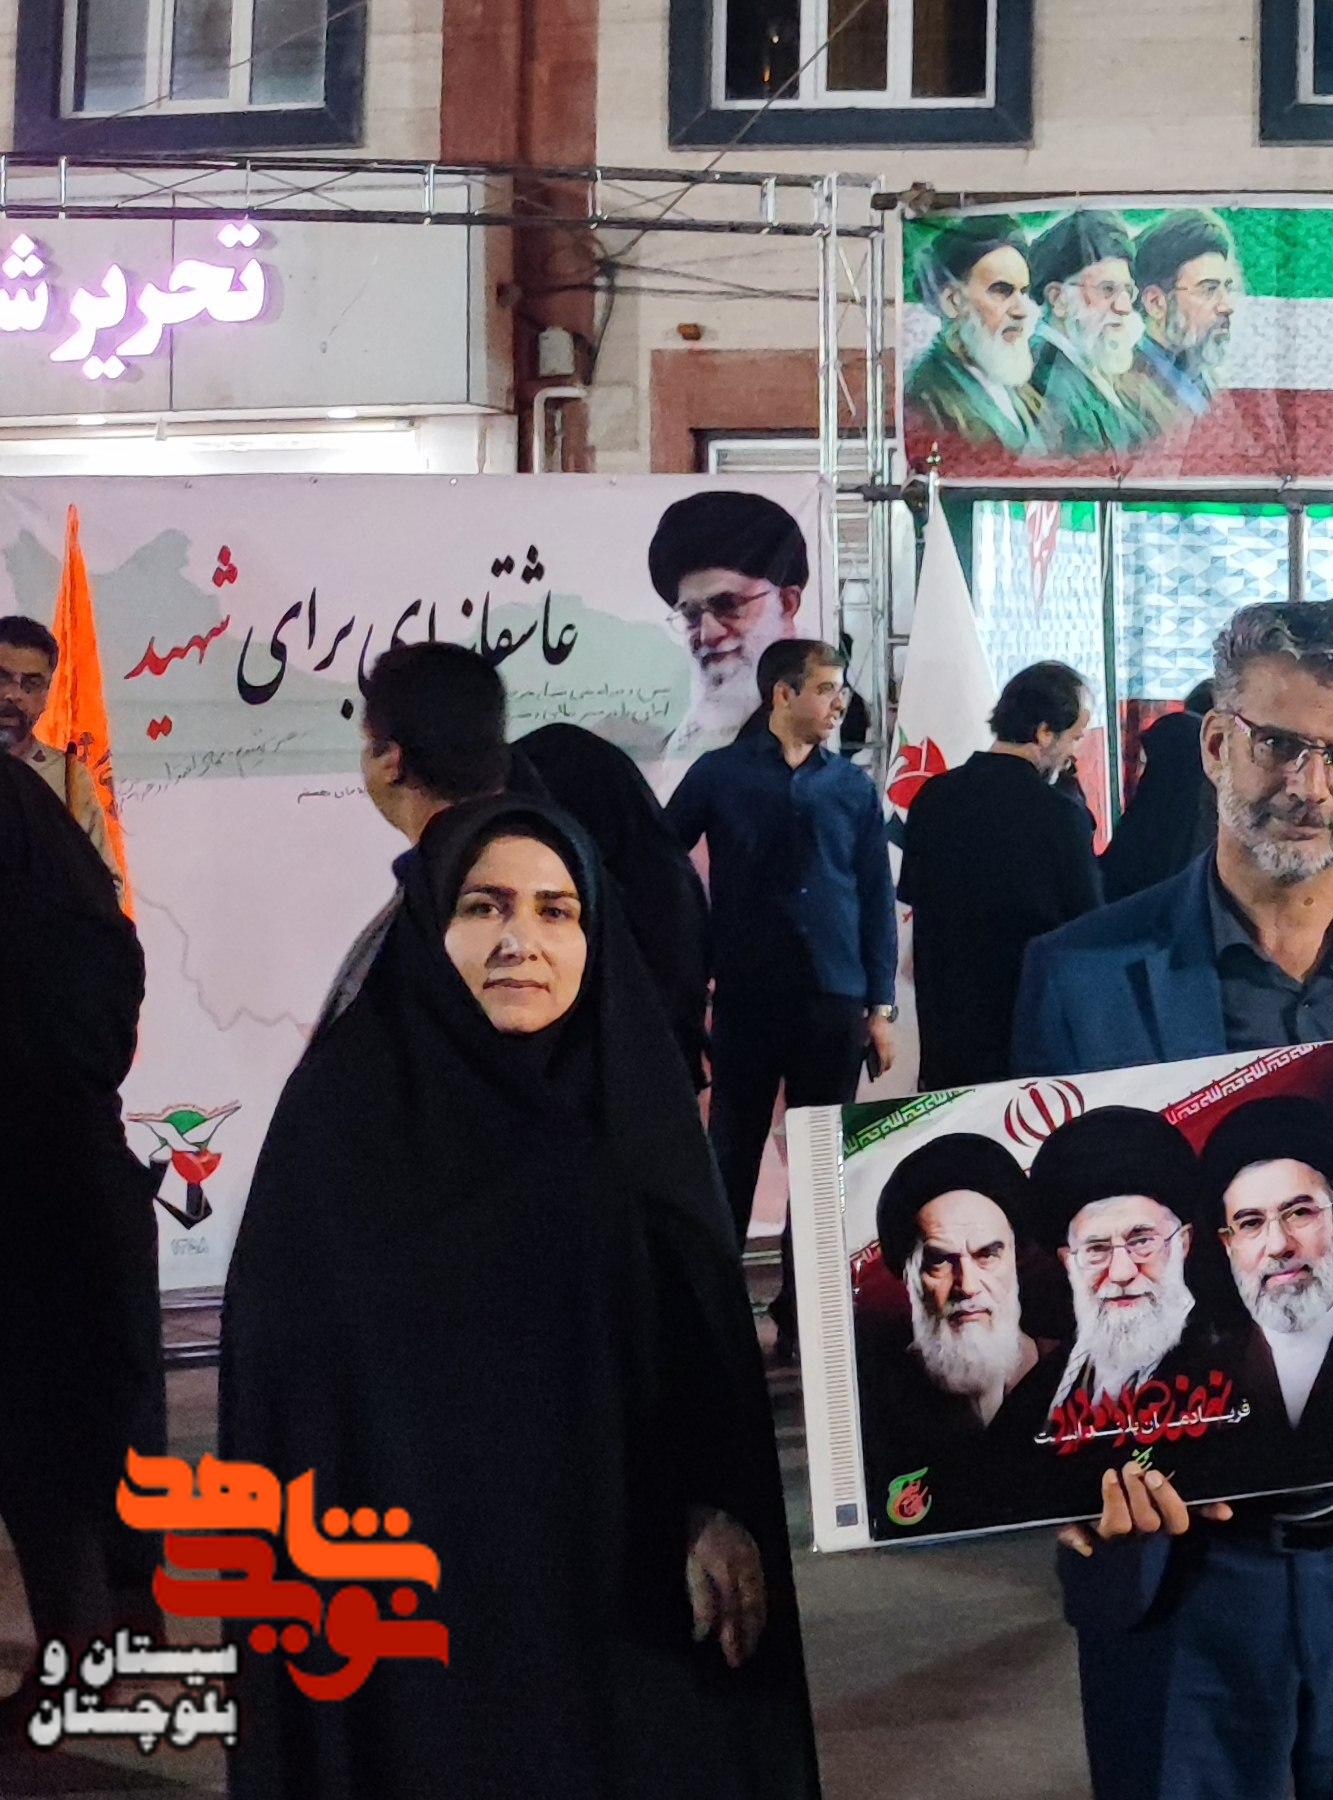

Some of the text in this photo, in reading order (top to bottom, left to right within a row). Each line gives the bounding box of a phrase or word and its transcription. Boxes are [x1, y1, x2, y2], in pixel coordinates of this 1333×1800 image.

[50, 222, 266, 380] تحریر
[123, 545, 239, 741] شهید
[237, 587, 356, 721] برای
